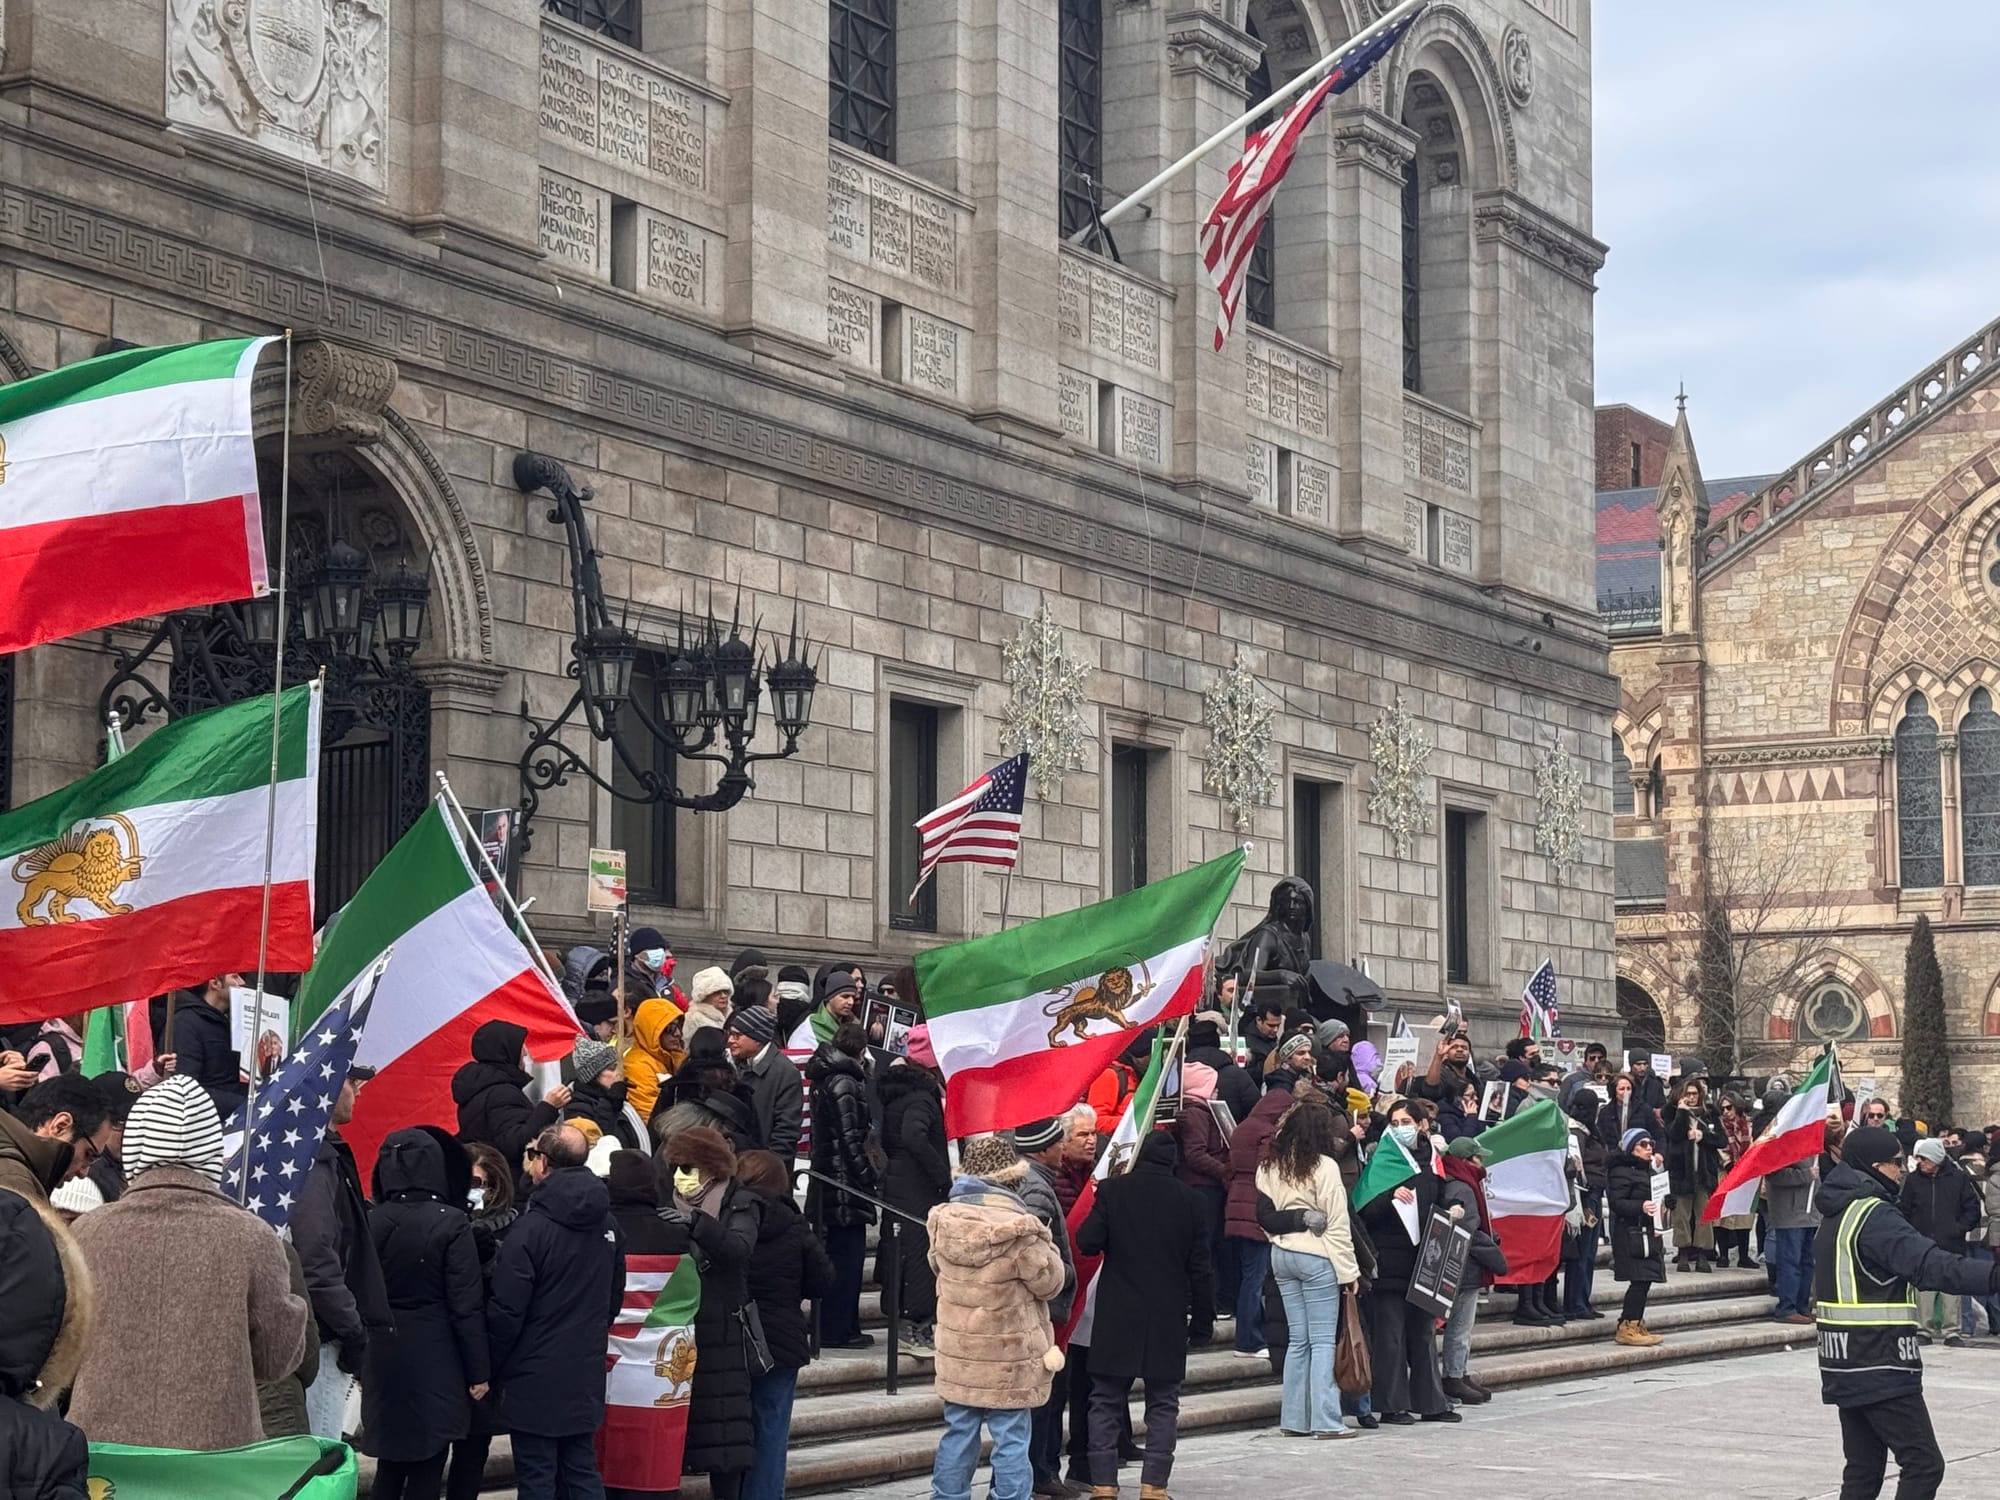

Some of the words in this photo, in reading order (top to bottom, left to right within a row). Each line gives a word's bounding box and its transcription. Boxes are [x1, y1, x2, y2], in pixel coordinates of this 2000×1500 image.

[541, 33, 582, 65] HOMER
[541, 53, 585, 85] SAPPHO
[601, 62, 645, 91] HORACE
[540, 74, 596, 108] ANACREON
[602, 81, 631, 104] OVID
[653, 82, 691, 110] DANTE
[540, 94, 595, 128] ARISTOPHANES
[653, 101, 689, 127] TASSO
[539, 112, 595, 148] SIMONIDES
[653, 120, 702, 150] BOCCACCIO
[652, 156, 700, 187] LEOPARDI
[541, 178, 582, 204] HESIOD
[540, 215, 595, 247] MENANDER
[651, 274, 695, 301] SPINOZA
